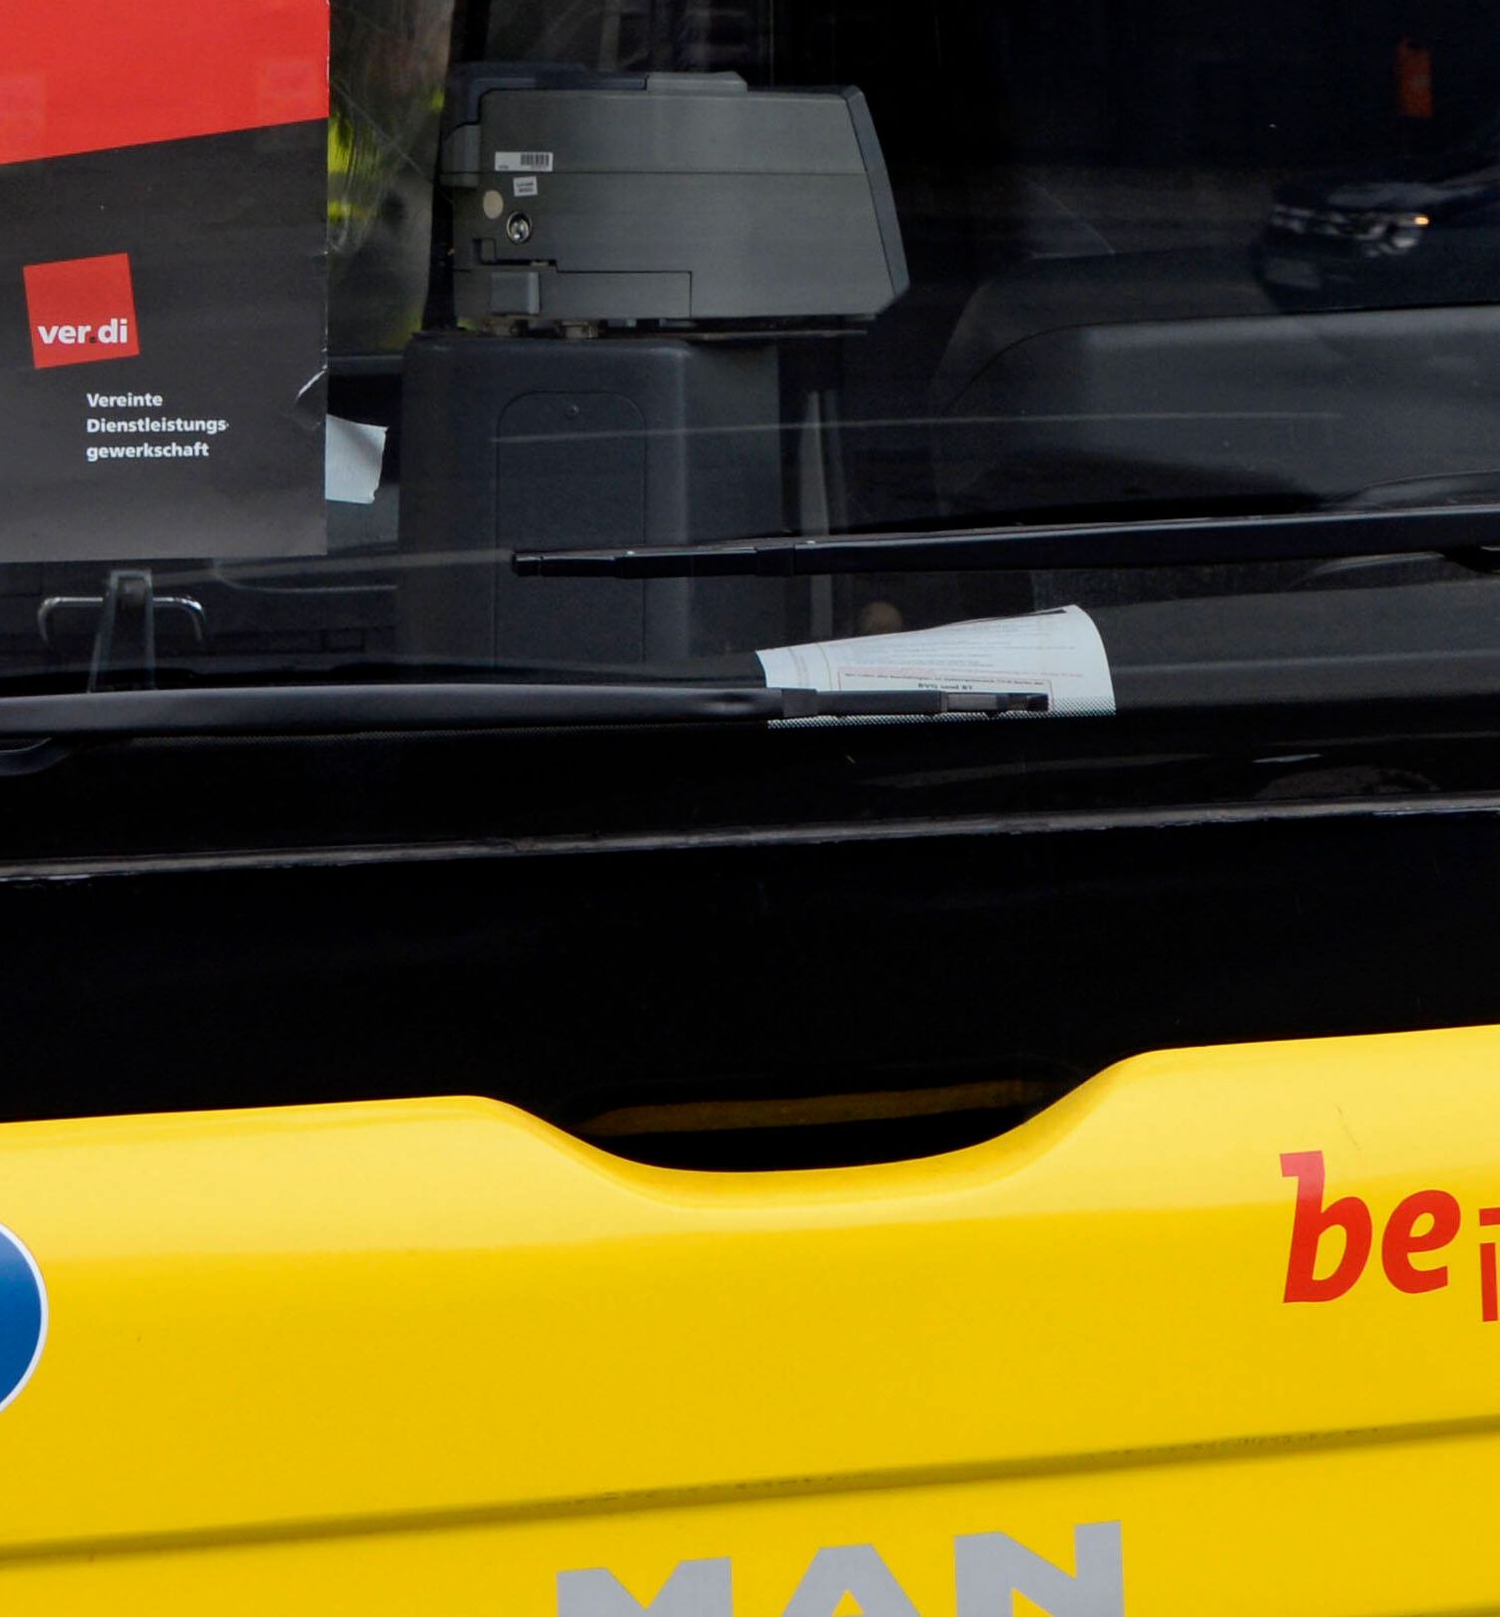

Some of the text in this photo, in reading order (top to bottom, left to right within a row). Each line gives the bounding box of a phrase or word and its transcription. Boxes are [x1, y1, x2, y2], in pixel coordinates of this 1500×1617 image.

[38, 318, 128, 345] ver.di
[86, 393, 163, 408] Vereinte
[86, 417, 229, 435] Dienstleistungs-
[86, 442, 209, 462] gewerkschaft
[1282, 1152, 1461, 1303] be
